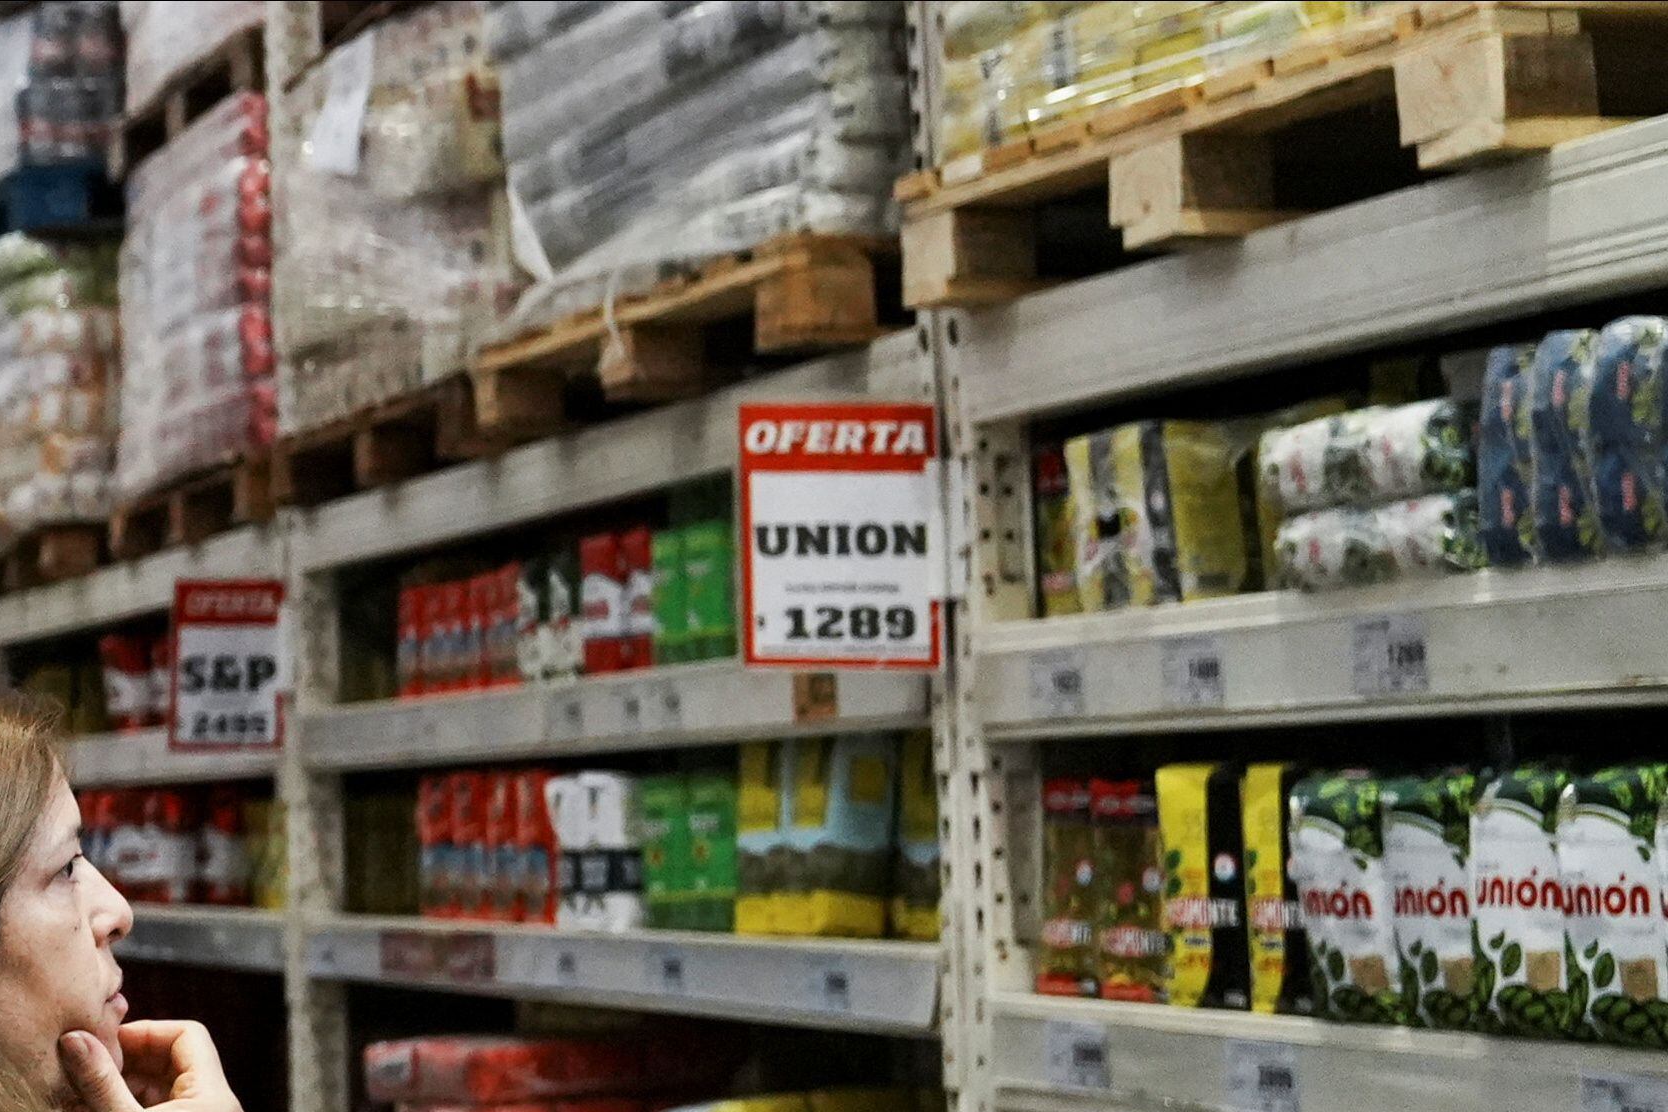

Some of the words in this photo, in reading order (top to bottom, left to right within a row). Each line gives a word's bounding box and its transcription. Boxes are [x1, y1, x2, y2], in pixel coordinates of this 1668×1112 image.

[744, 419, 926, 455] OFERTA
[755, 523, 927, 557] UNION
[785, 606, 916, 640] 1289
[182, 654, 277, 694] S&P
